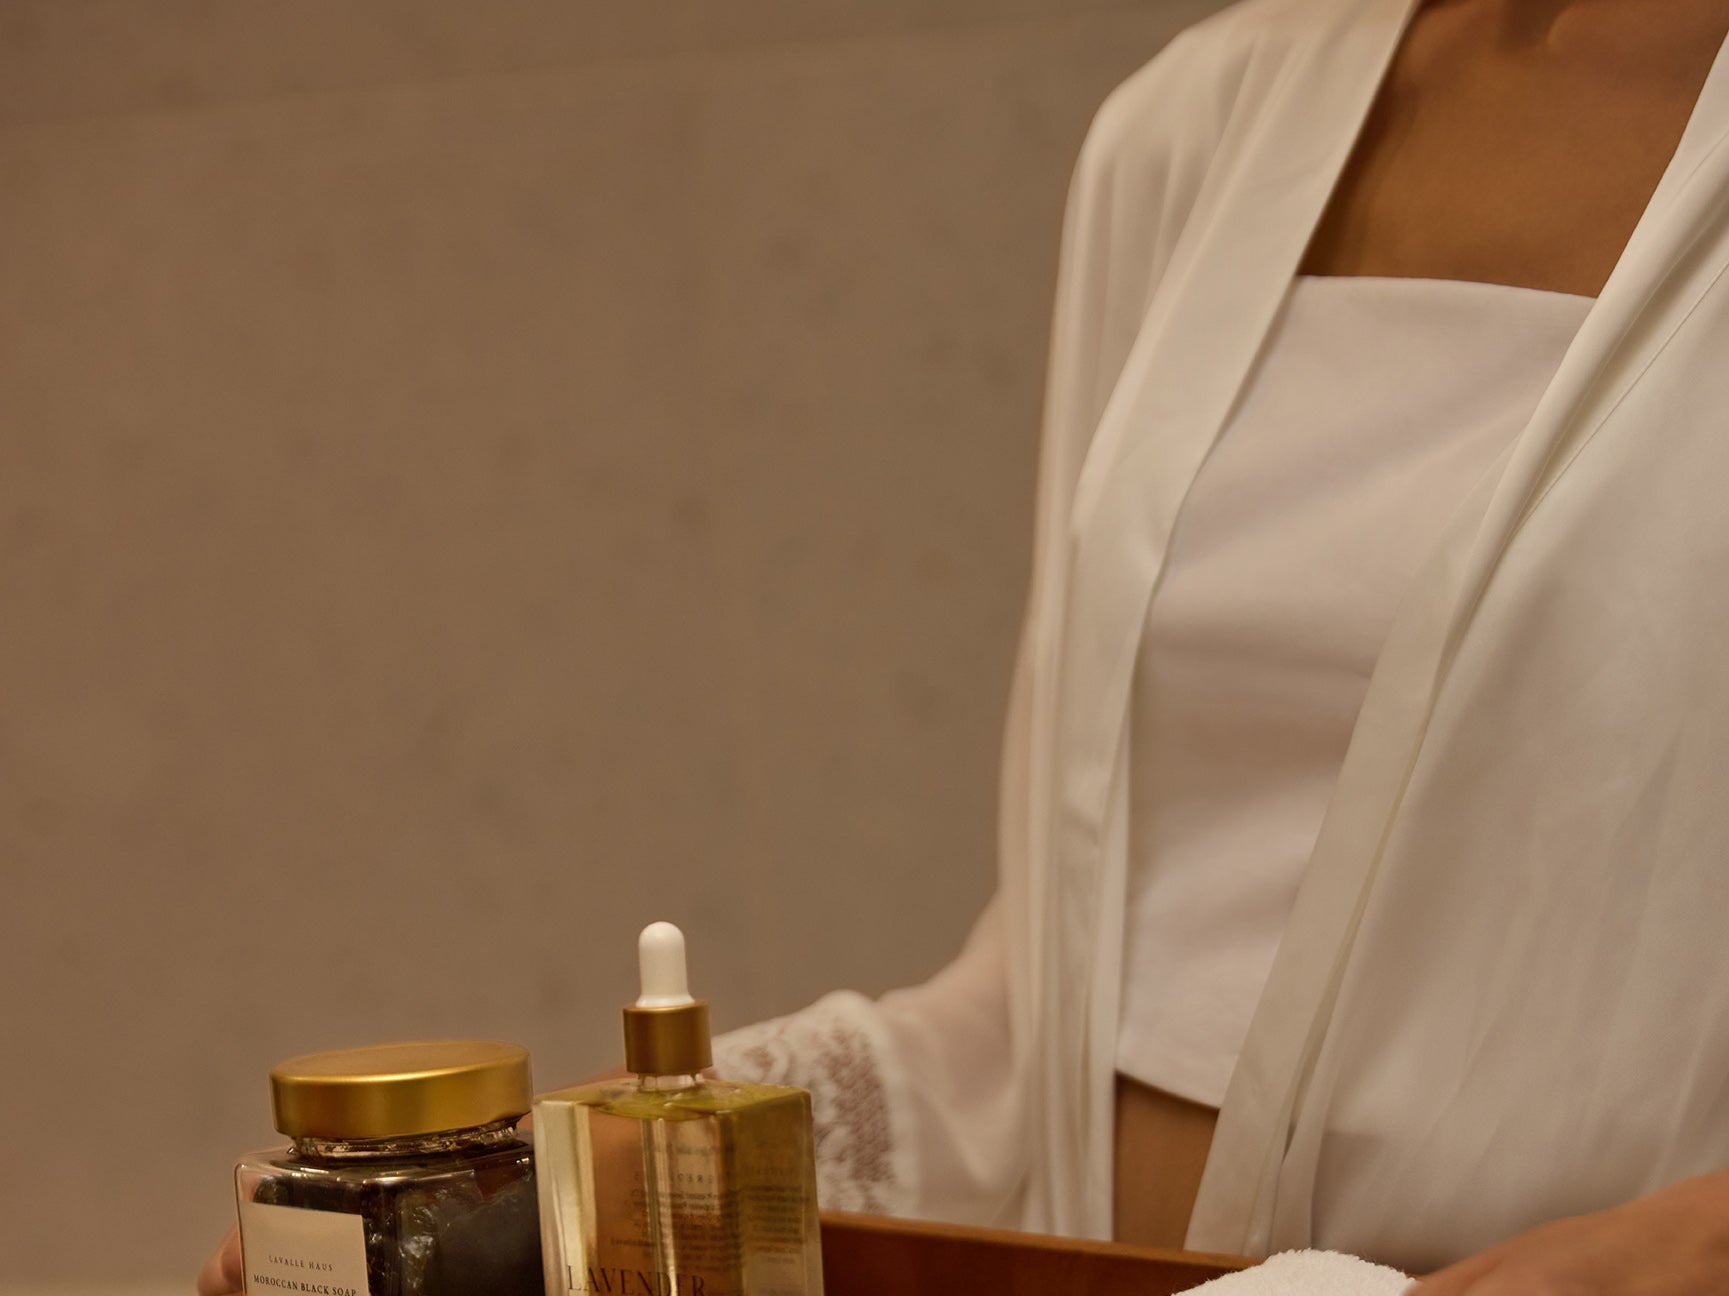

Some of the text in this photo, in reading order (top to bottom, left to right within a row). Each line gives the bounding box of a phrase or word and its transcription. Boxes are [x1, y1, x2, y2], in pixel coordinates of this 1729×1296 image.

[309, 1263, 334, 1272] HAUS
[254, 1274, 298, 1291] MOROCCAN
[301, 1283, 330, 1295] BLACK
